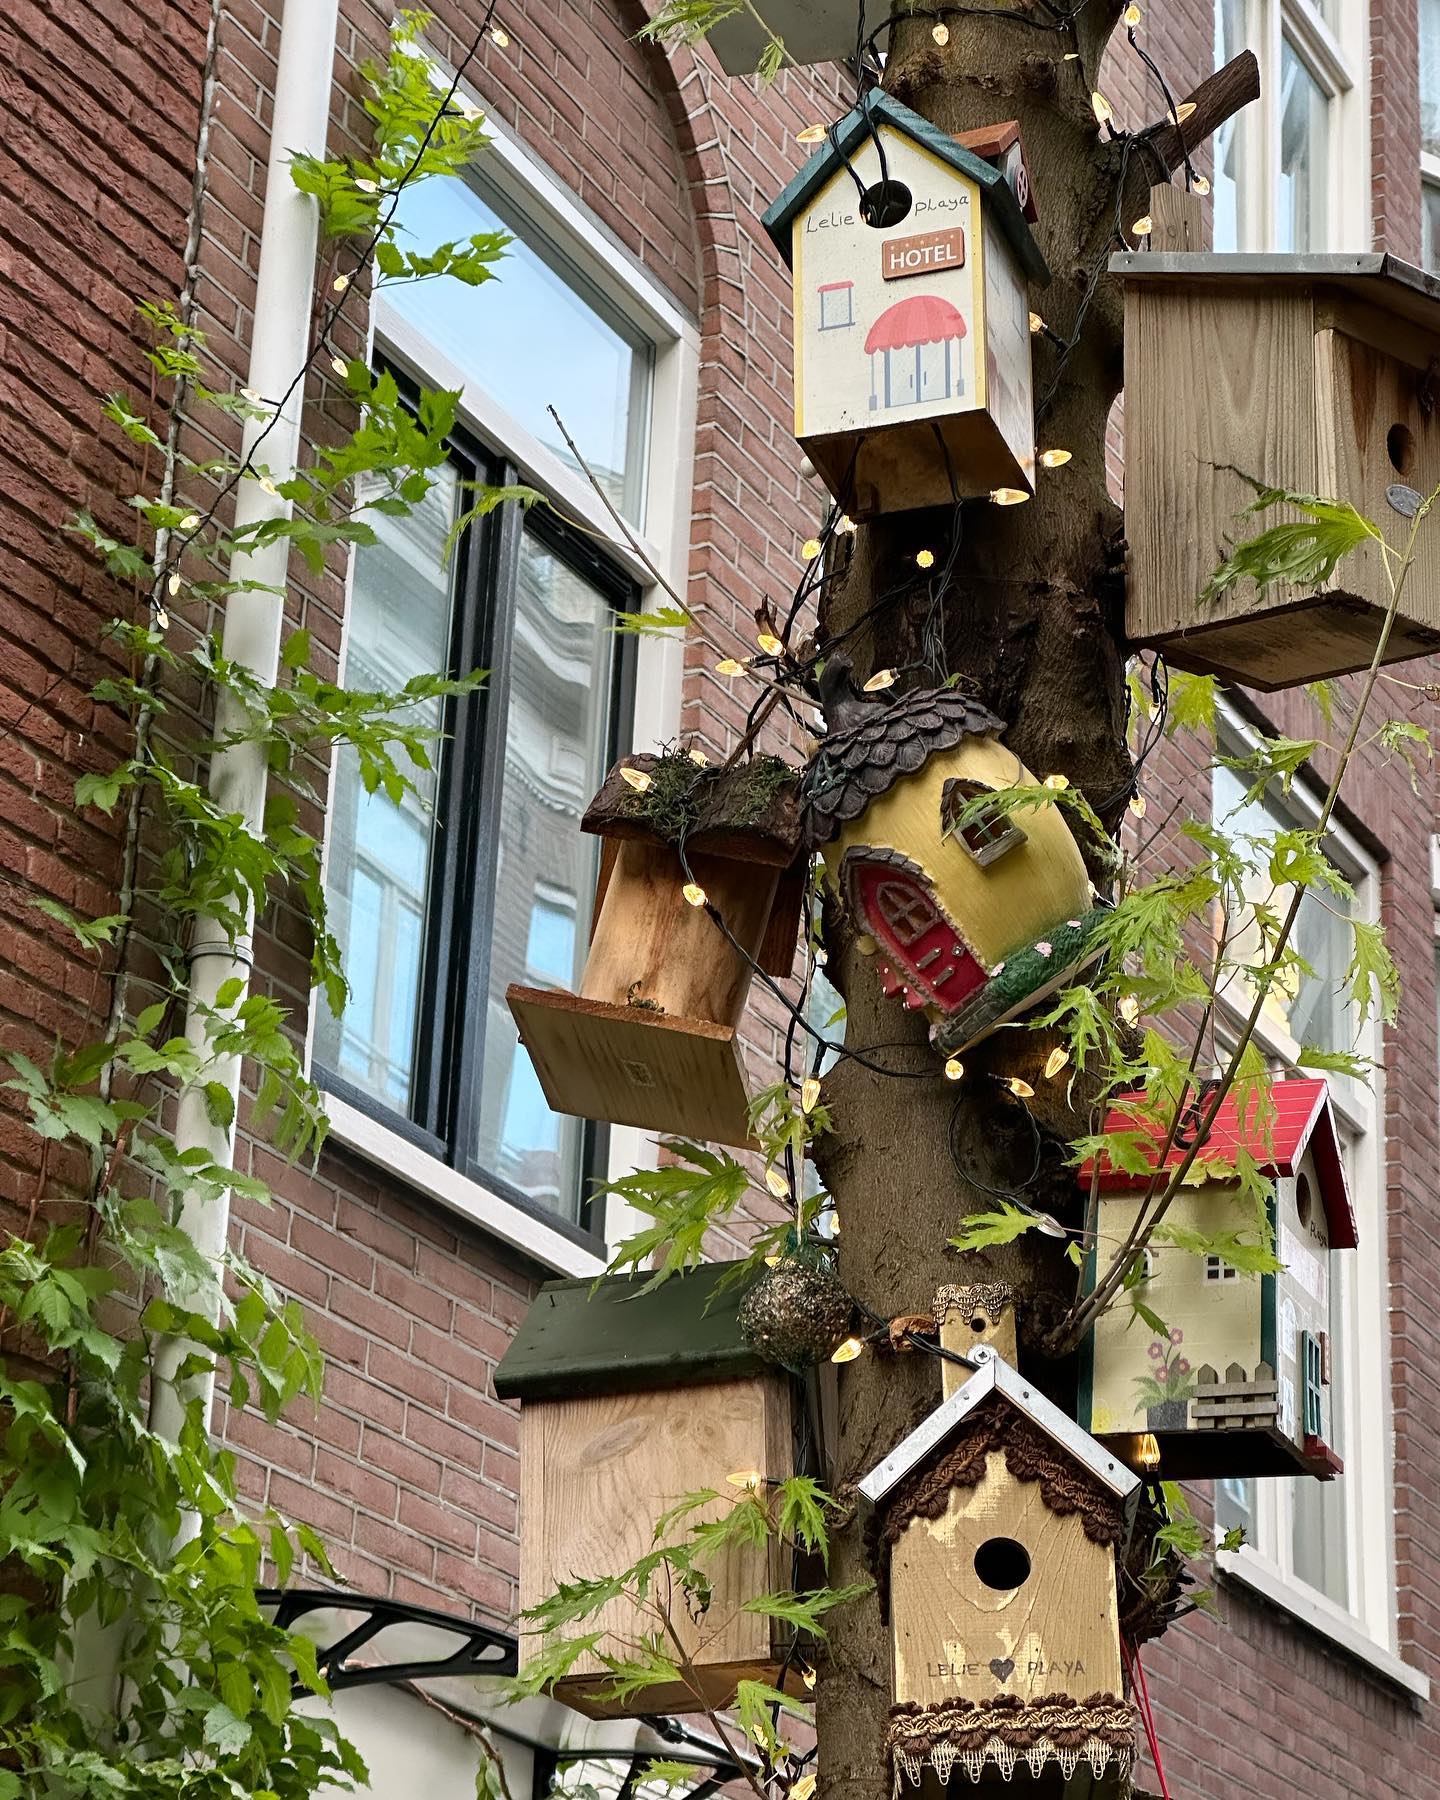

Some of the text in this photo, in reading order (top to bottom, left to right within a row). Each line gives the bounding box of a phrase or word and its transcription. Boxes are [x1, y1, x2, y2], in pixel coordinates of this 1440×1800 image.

[806, 211, 855, 233] Lelie
[890, 243, 957, 270] HOTEL
[927, 1660, 1085, 1678] LELIE PLAYA
